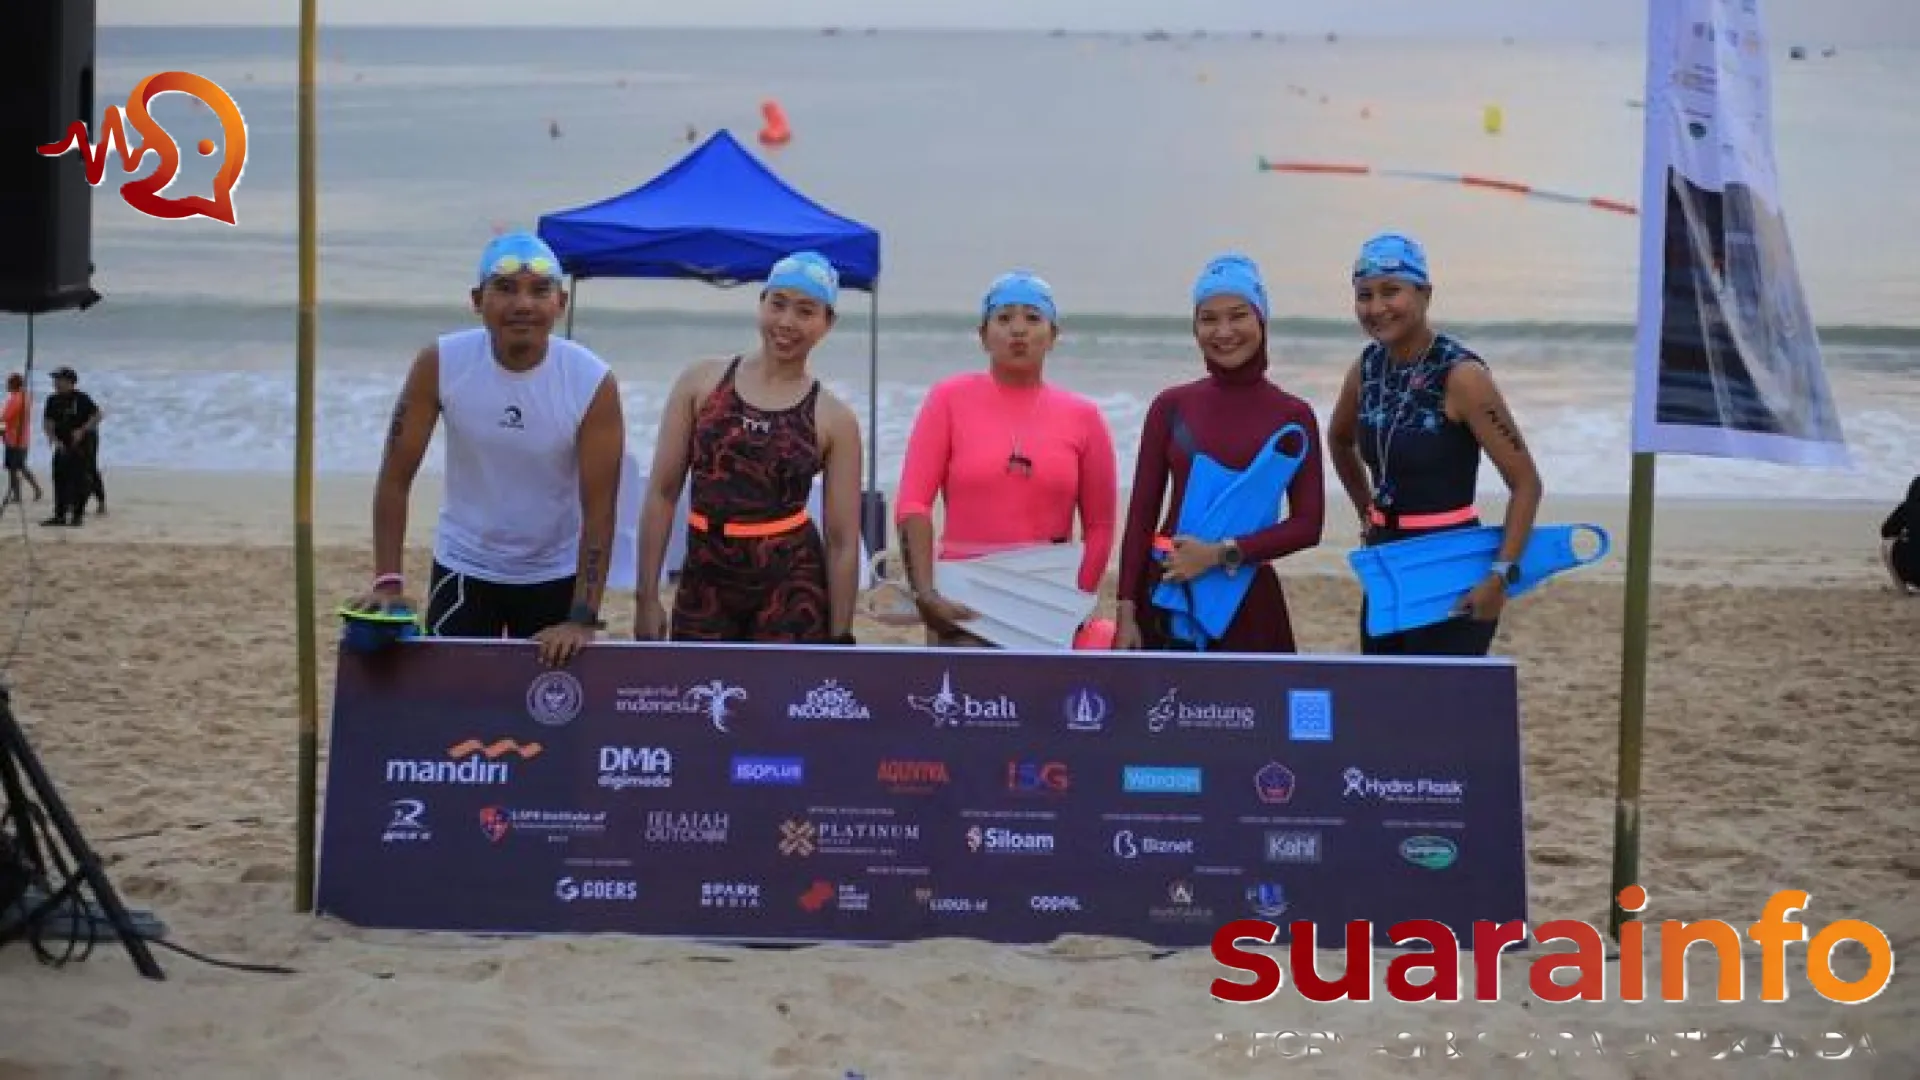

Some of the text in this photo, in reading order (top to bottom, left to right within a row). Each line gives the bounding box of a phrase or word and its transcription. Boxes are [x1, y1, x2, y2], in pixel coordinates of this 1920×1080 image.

[787, 703, 871, 719] INDONESIA
[963, 695, 1017, 719] bali
[1178, 701, 1255, 723] badung
[385, 754, 509, 785] mandiri
[600, 748, 672, 774] DMA
[1365, 778, 1464, 797] Hydro Flask
[818, 822, 920, 840] PLATINUM
[984, 827, 1054, 848] Siloam
[1143, 837, 1194, 853] Biznet
